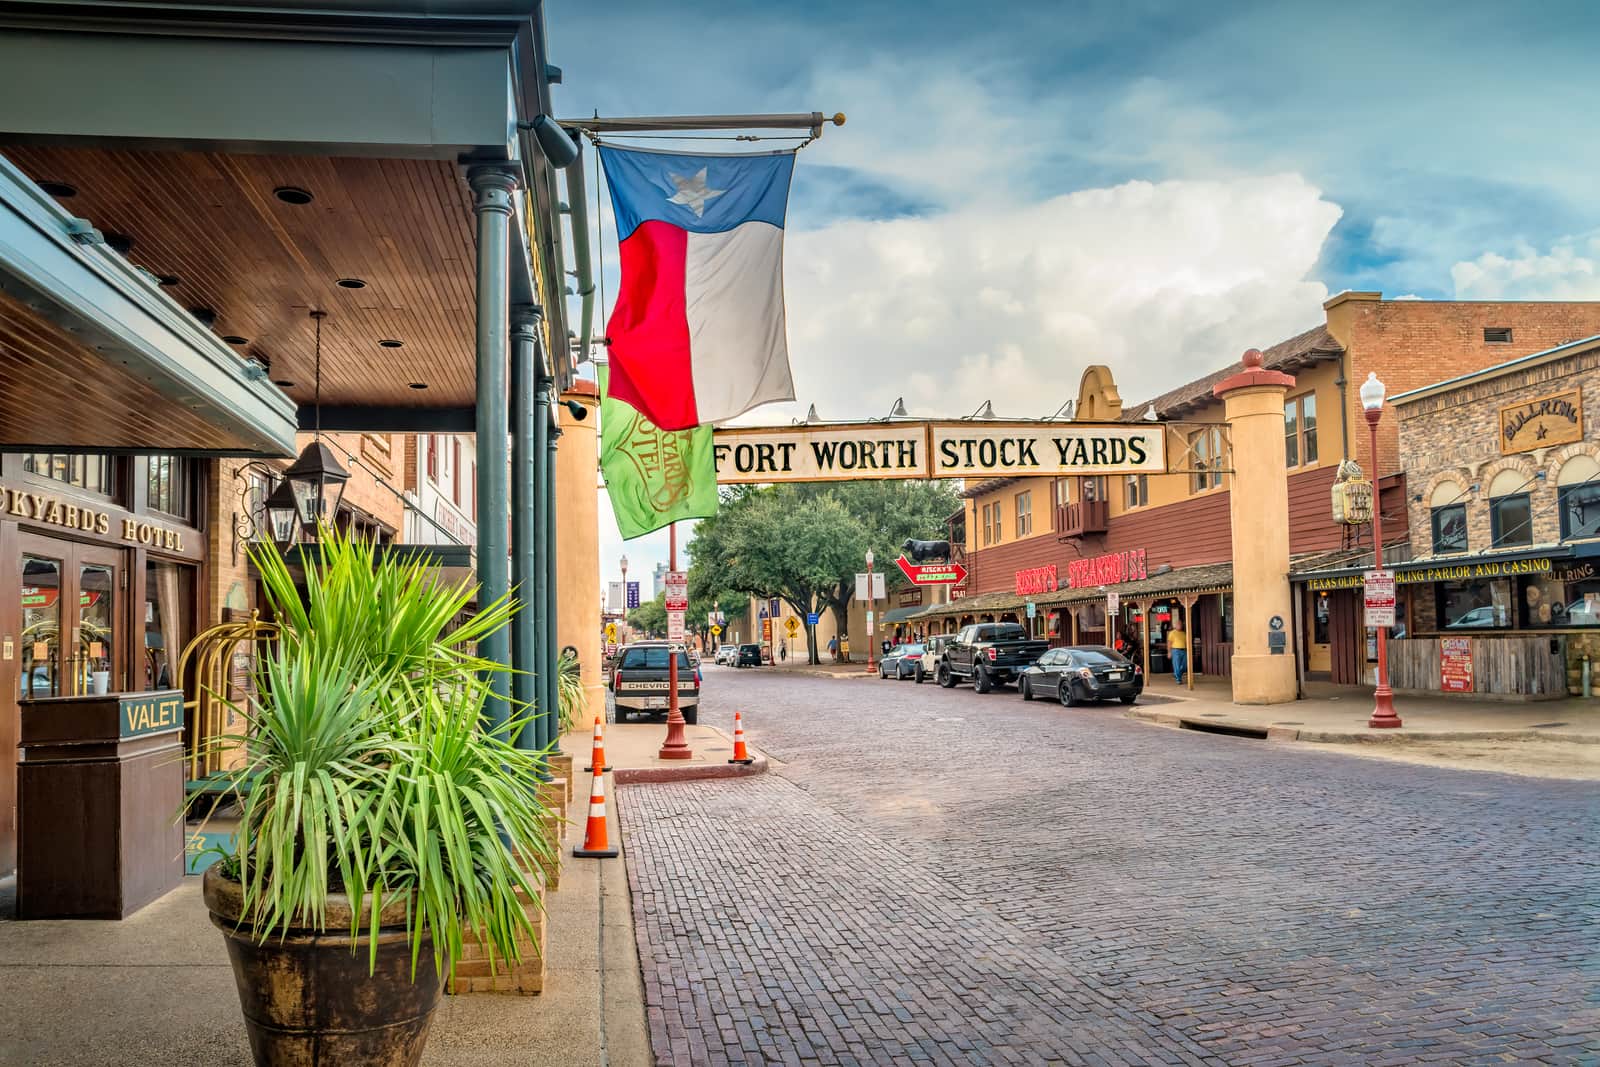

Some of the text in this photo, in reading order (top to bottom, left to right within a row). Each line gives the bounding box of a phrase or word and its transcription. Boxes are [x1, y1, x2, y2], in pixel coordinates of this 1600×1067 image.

[631, 419, 660, 479] OTEL
[714, 435, 1147, 474] FORT WORTH STOCK YARDS
[123, 518, 185, 553] HOTEL
[1068, 548, 1147, 589] STEAKHOUSE
[1307, 558, 1550, 590] TEXAS OLDES BLING PARLOR AND CASINO
[1566, 563, 1595, 582] RING
[127, 700, 180, 731] VALET
